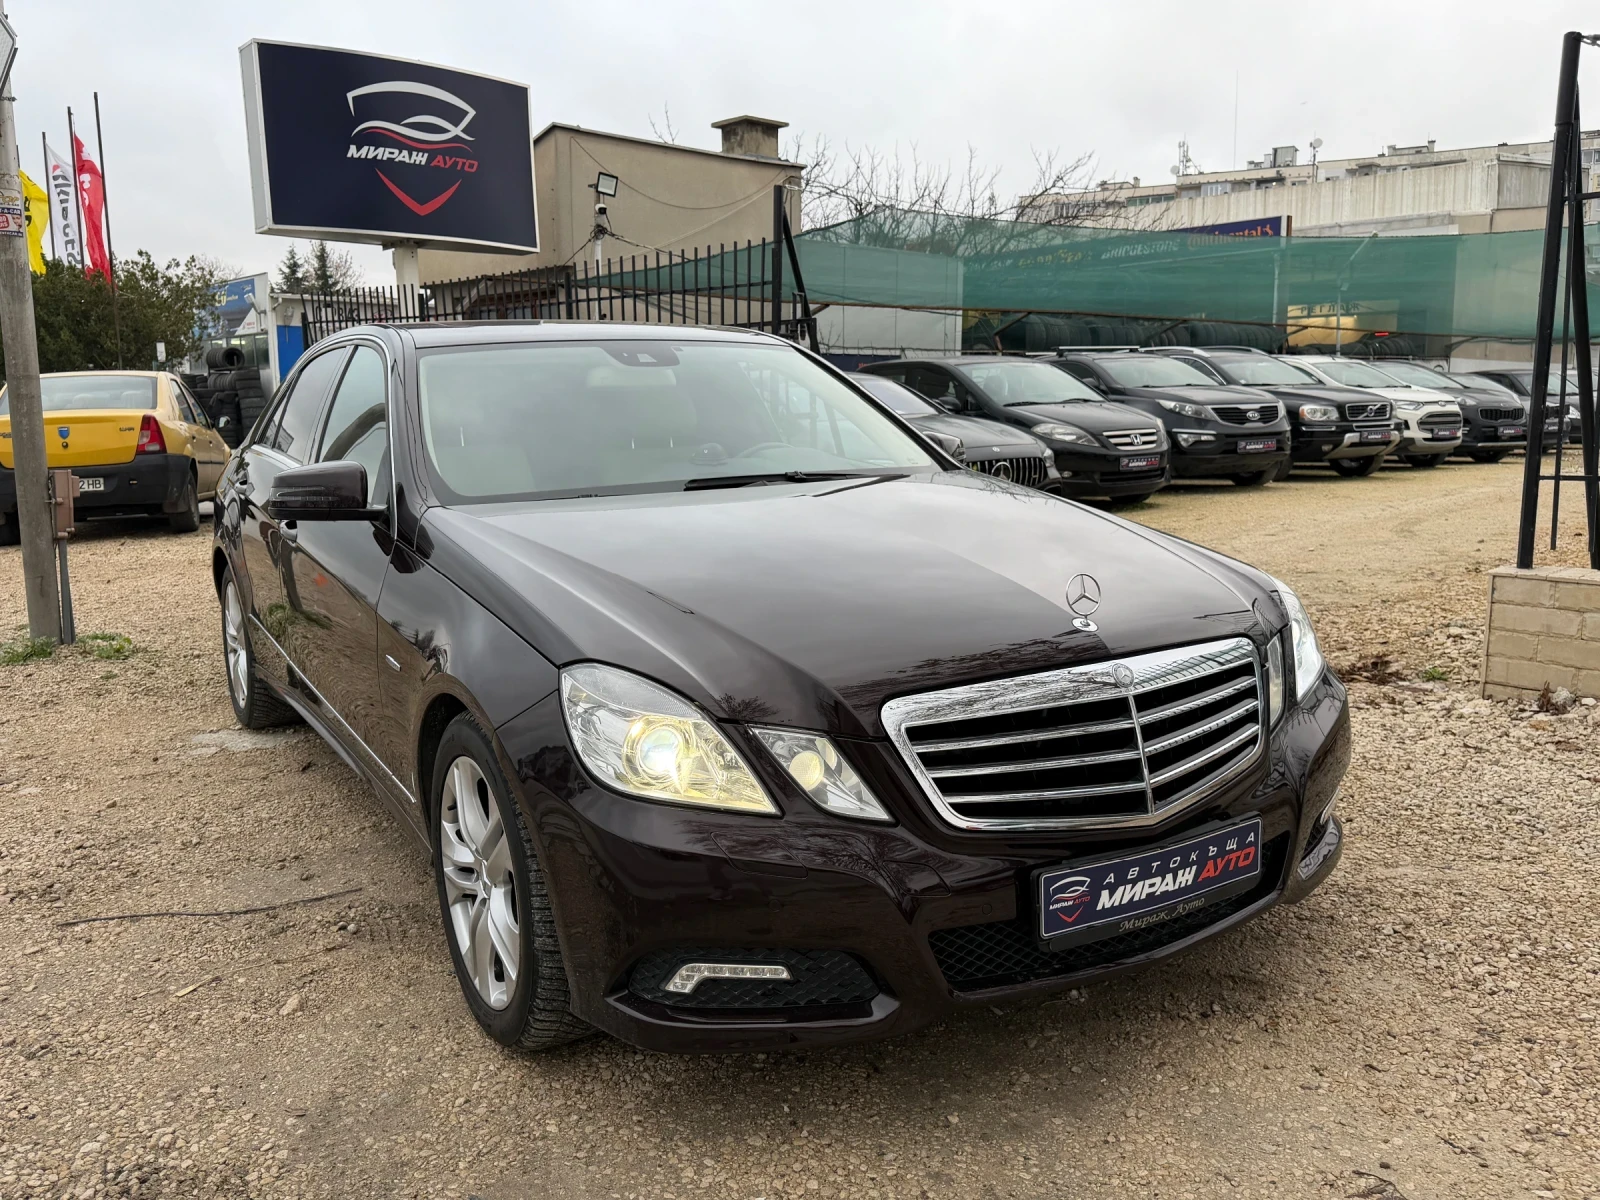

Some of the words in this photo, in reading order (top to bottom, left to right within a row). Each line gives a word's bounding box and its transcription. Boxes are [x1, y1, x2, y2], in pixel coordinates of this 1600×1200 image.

[347, 144, 428, 165] МИРАЖ
[430, 155, 478, 173] АУТО
[1096, 865, 1197, 911] МИРАЖ
[1198, 846, 1256, 882] АУТО
[1103, 832, 1255, 885] АВТОКЪЩА
